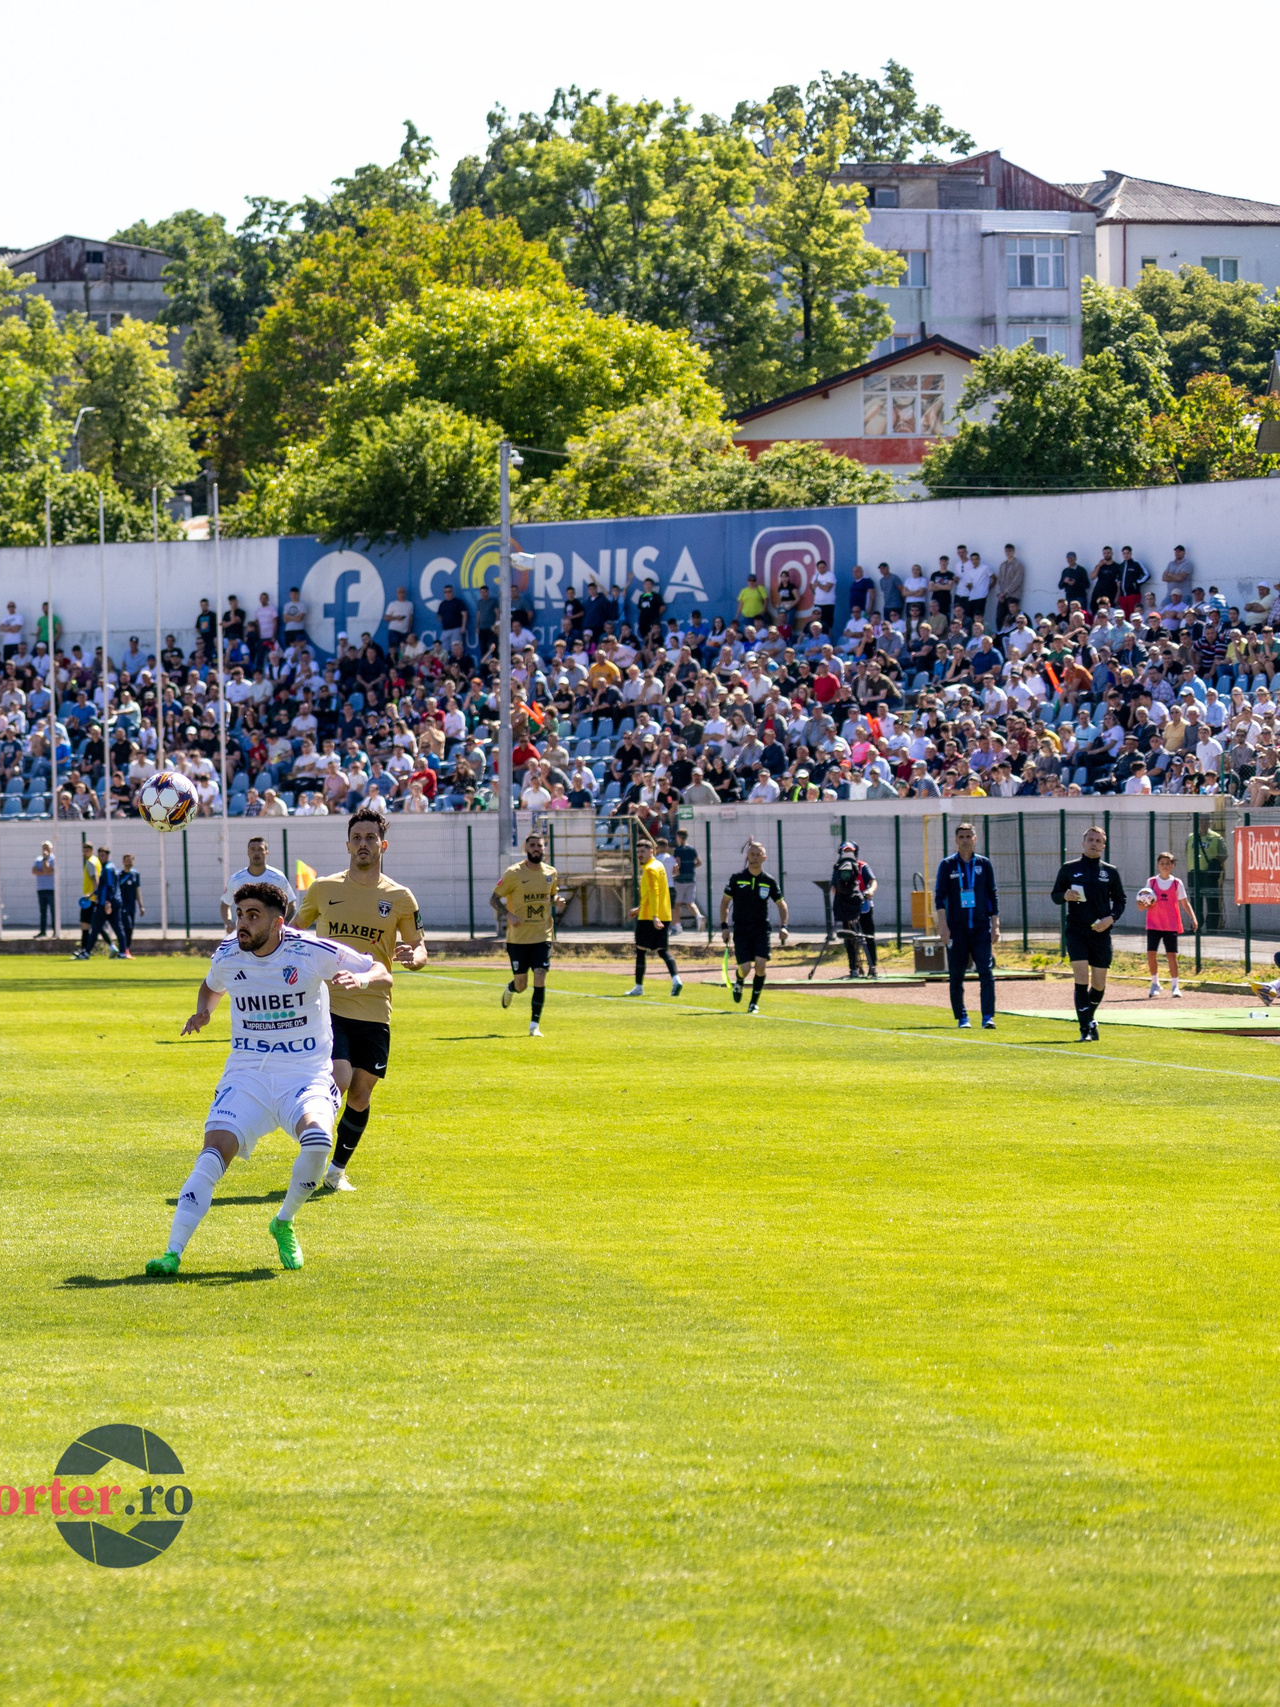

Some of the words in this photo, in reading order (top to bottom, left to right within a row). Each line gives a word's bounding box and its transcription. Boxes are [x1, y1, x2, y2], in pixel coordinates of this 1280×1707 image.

[329, 921, 385, 942] MAXBET
[236, 991, 306, 1012] UNIBET
[276, 1020, 293, 1029] SPRE
[294, 1018, 305, 1026] 0%
[233, 1037, 317, 1053] ELSACO
